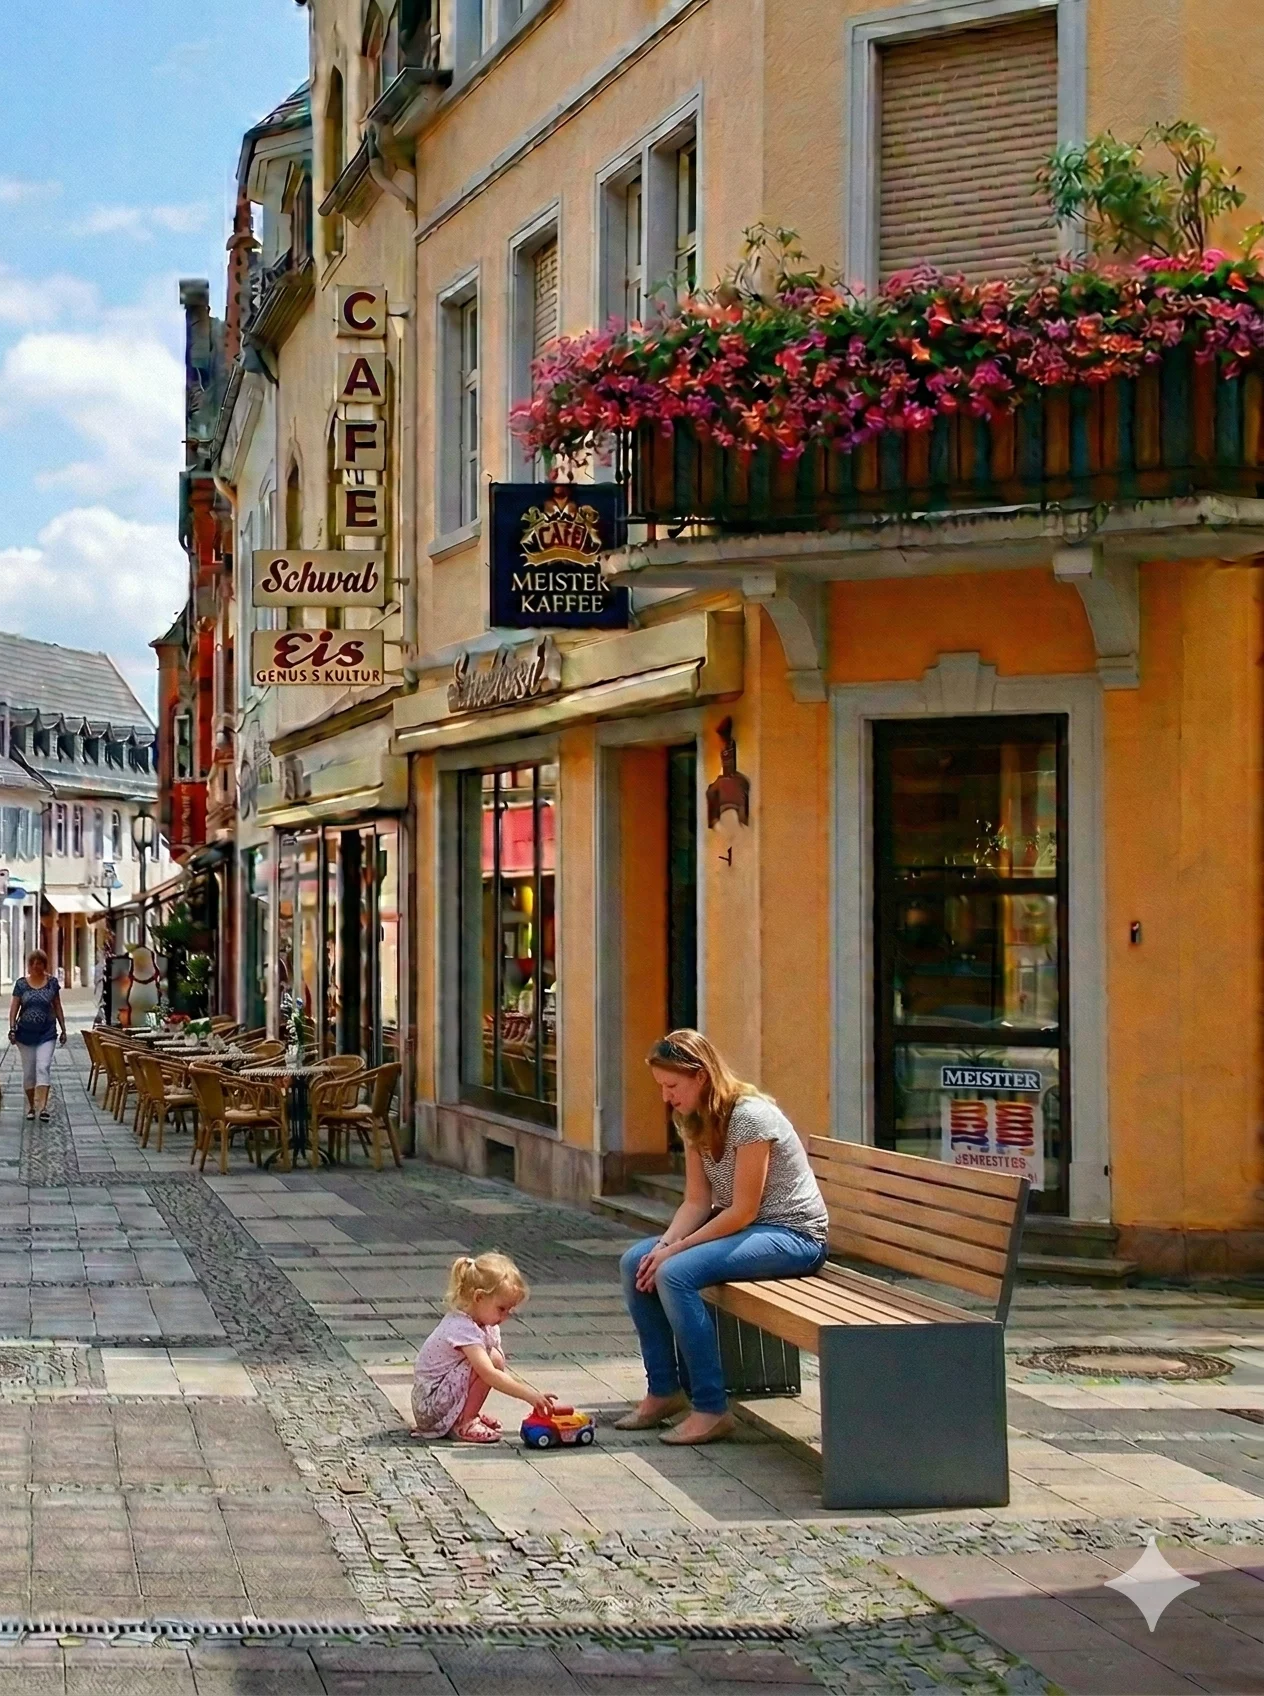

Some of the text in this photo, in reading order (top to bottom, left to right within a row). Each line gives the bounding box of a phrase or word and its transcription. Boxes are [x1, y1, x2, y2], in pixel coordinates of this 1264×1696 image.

[261, 558, 379, 593] Schwab
[511, 572, 610, 592] MEISTER
[521, 594, 604, 613] KAFFEE
[273, 630, 365, 669] Eis
[324, 669, 381, 683] KULTUR
